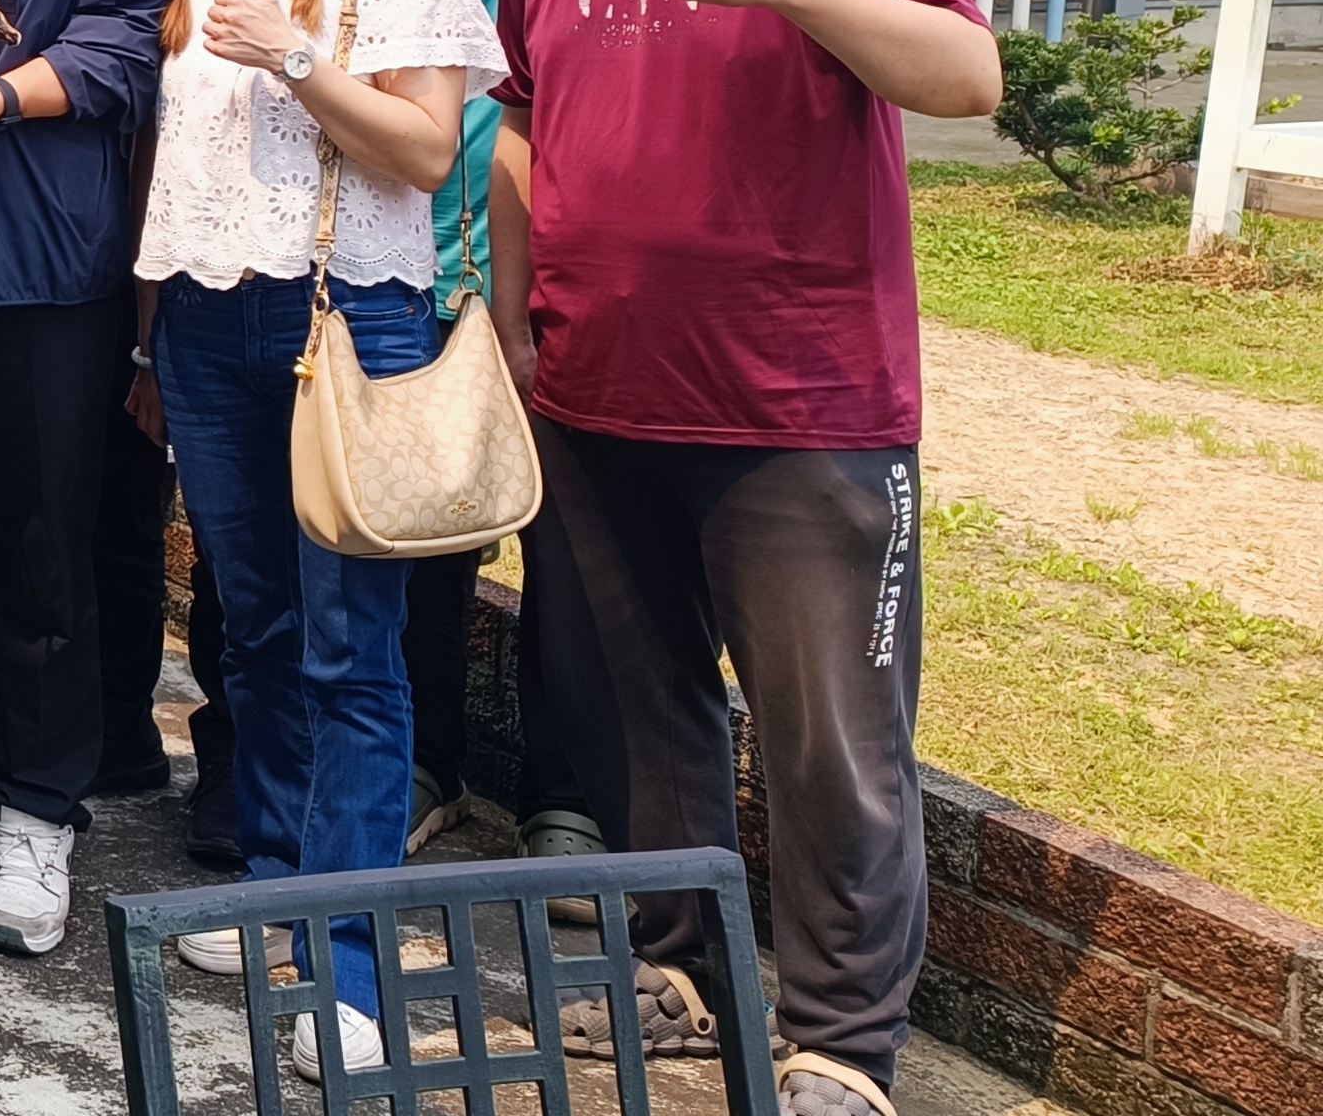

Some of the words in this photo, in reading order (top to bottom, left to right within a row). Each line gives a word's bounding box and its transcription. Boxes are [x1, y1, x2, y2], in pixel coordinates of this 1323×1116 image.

[891, 463, 912, 553] STRIKE
[890, 562, 905, 578] &
[874, 585, 901, 667] FORCE
